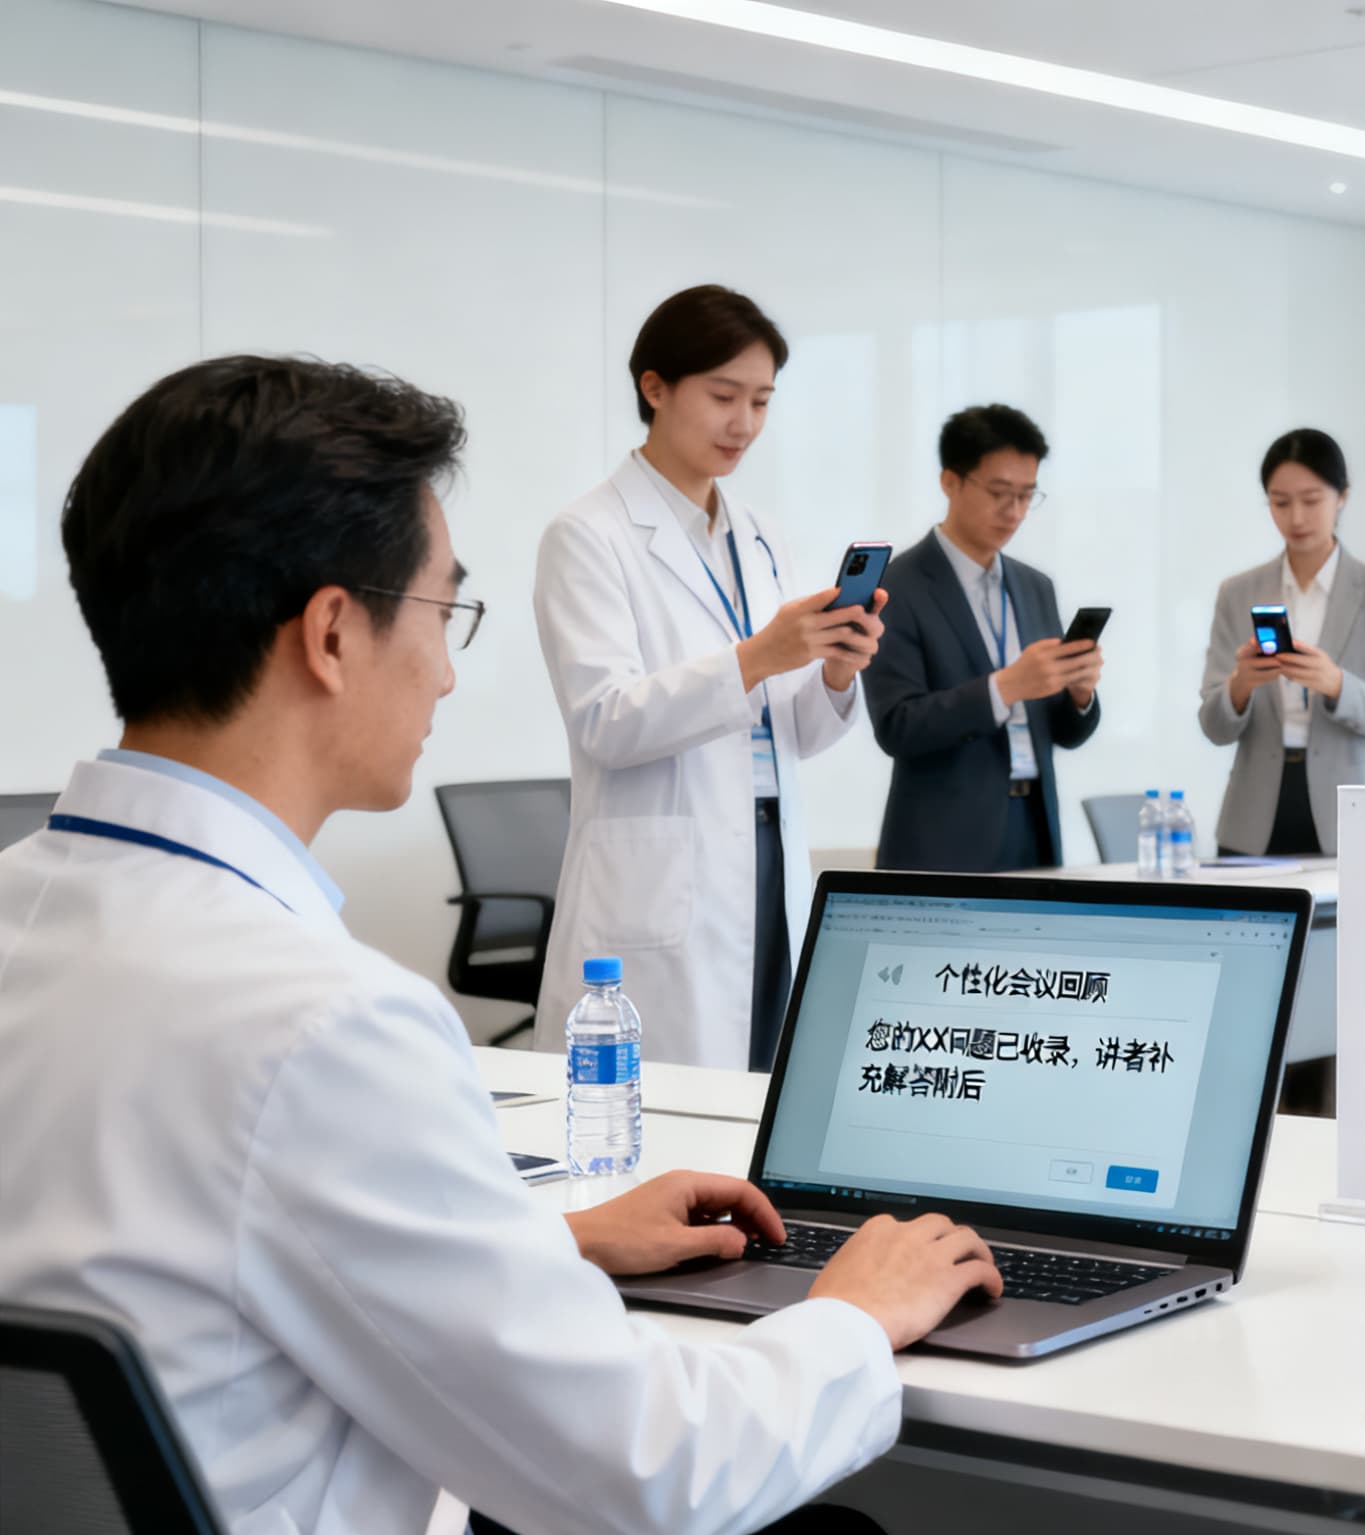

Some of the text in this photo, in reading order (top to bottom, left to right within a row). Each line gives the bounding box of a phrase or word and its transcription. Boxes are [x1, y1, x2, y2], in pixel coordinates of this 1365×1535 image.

[935, 962, 1111, 1004] 个性化会议回顾
